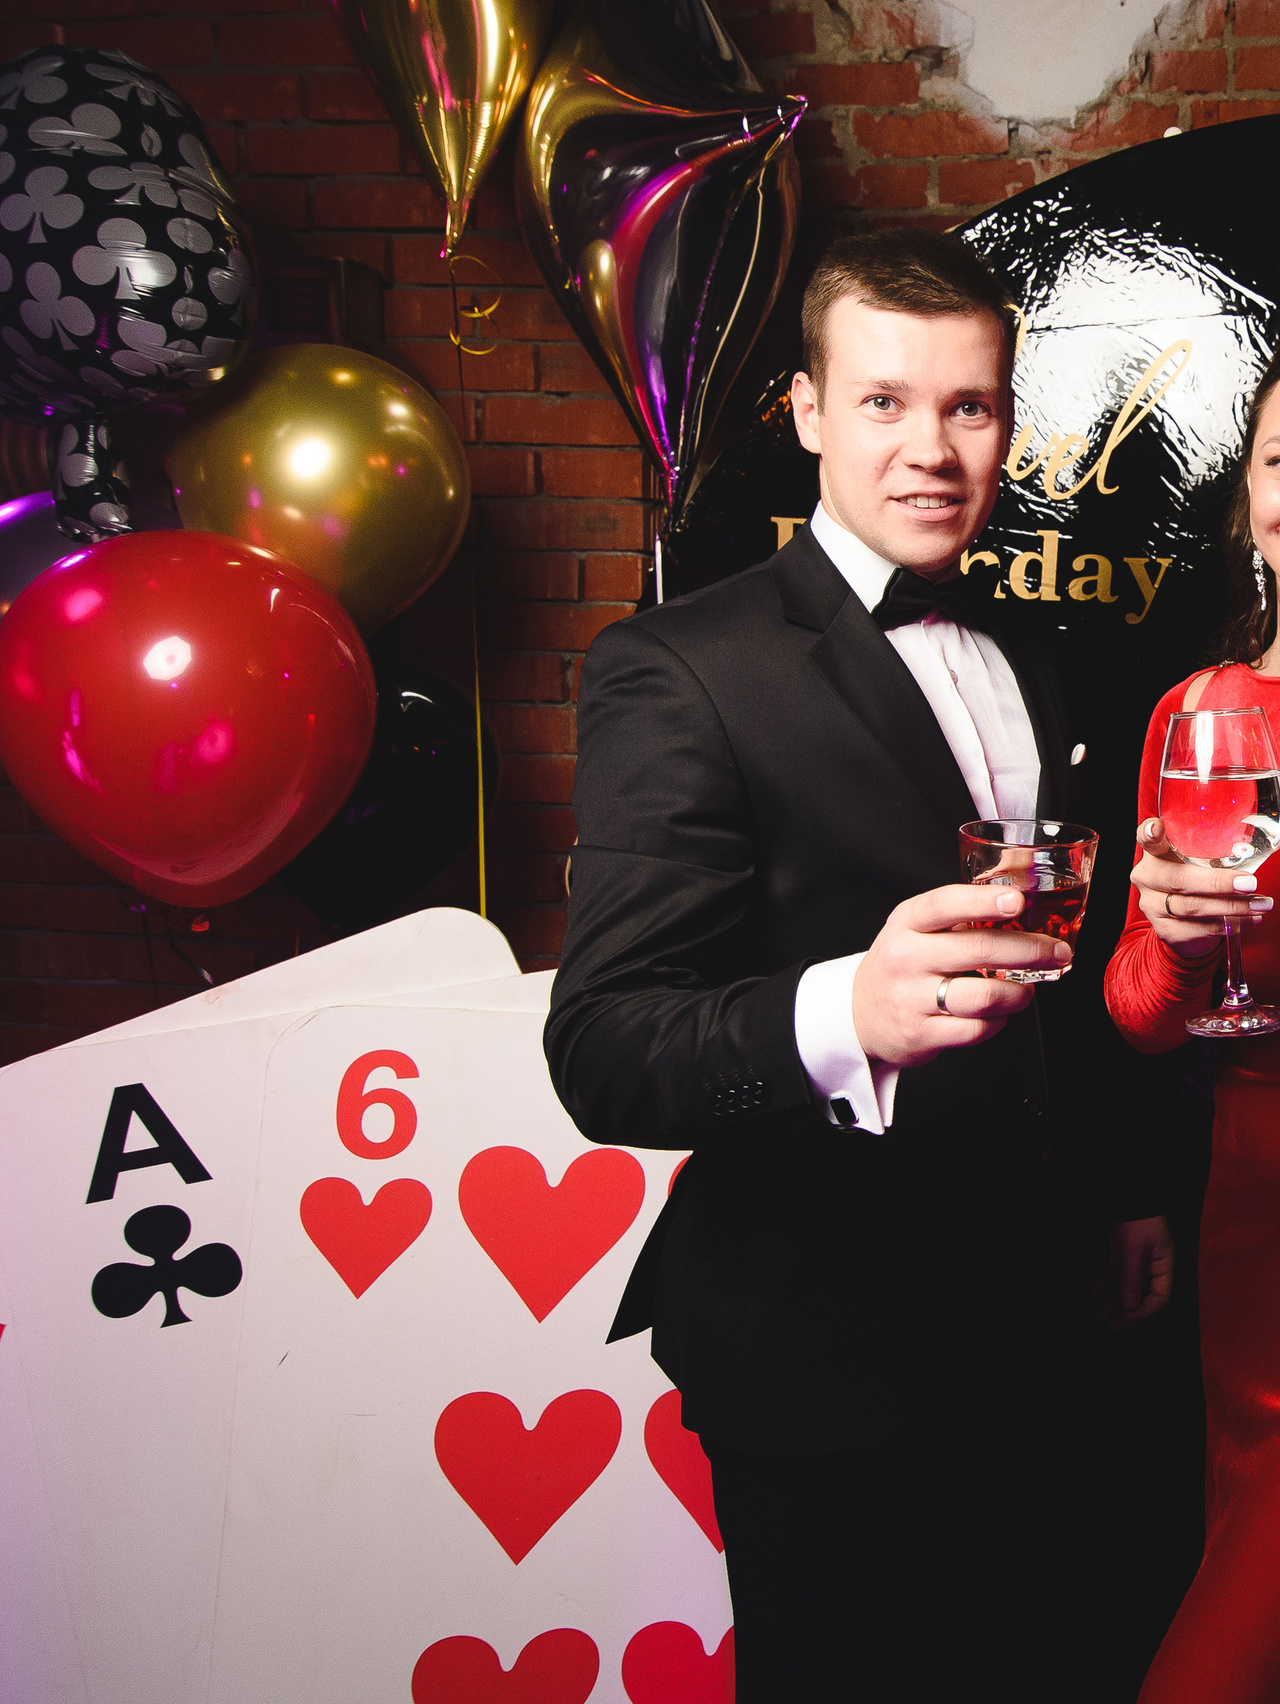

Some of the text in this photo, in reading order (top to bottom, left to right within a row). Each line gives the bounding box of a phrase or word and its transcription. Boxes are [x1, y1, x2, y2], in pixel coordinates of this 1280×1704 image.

[1003, 303, 1192, 500] vel
[86, 1083, 213, 1204] A
[336, 1050, 420, 1160] 6
